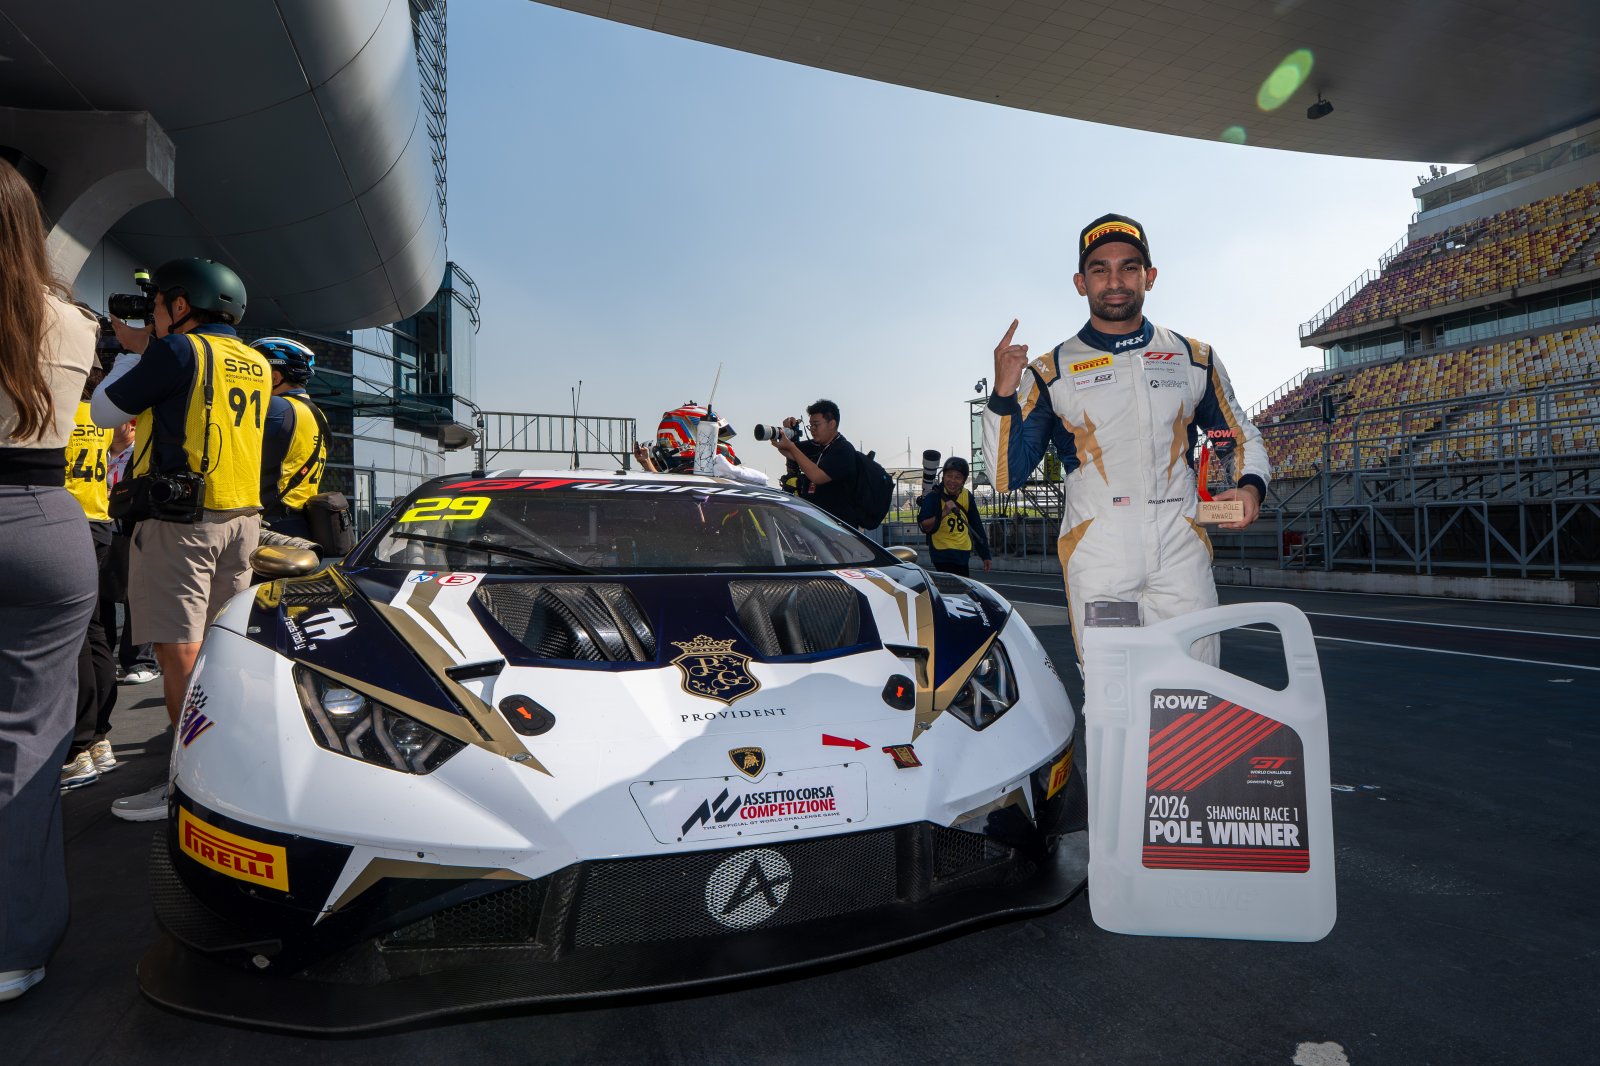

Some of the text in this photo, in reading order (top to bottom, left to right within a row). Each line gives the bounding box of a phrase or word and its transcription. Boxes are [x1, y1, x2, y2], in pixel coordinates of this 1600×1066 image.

[1115, 335, 1145, 349] HRX
[1073, 357, 1110, 372] PIRELLI
[1143, 352, 1184, 361] GT
[224, 358, 264, 377] SRO
[228, 386, 262, 429] 91
[1207, 429, 1238, 439] ROWE
[72, 448, 106, 482] 46
[437, 478, 790, 501] GT WORLD
[399, 496, 492, 523] 29
[1223, 503, 1240, 511] POLE
[947, 515, 965, 533] 98
[1153, 694, 1208, 710] ROWE
[680, 708, 787, 722] PROVIDENT
[1248, 756, 1297, 769] GT
[743, 786, 834, 806] ASSETTO CORSA
[740, 798, 837, 820] COMPETIZIONE
[1148, 795, 1299, 822] 2026 SHANGHAI RACE 1
[1149, 820, 1301, 847] POLE WINNER
[184, 819, 275, 880] PIRELLI
